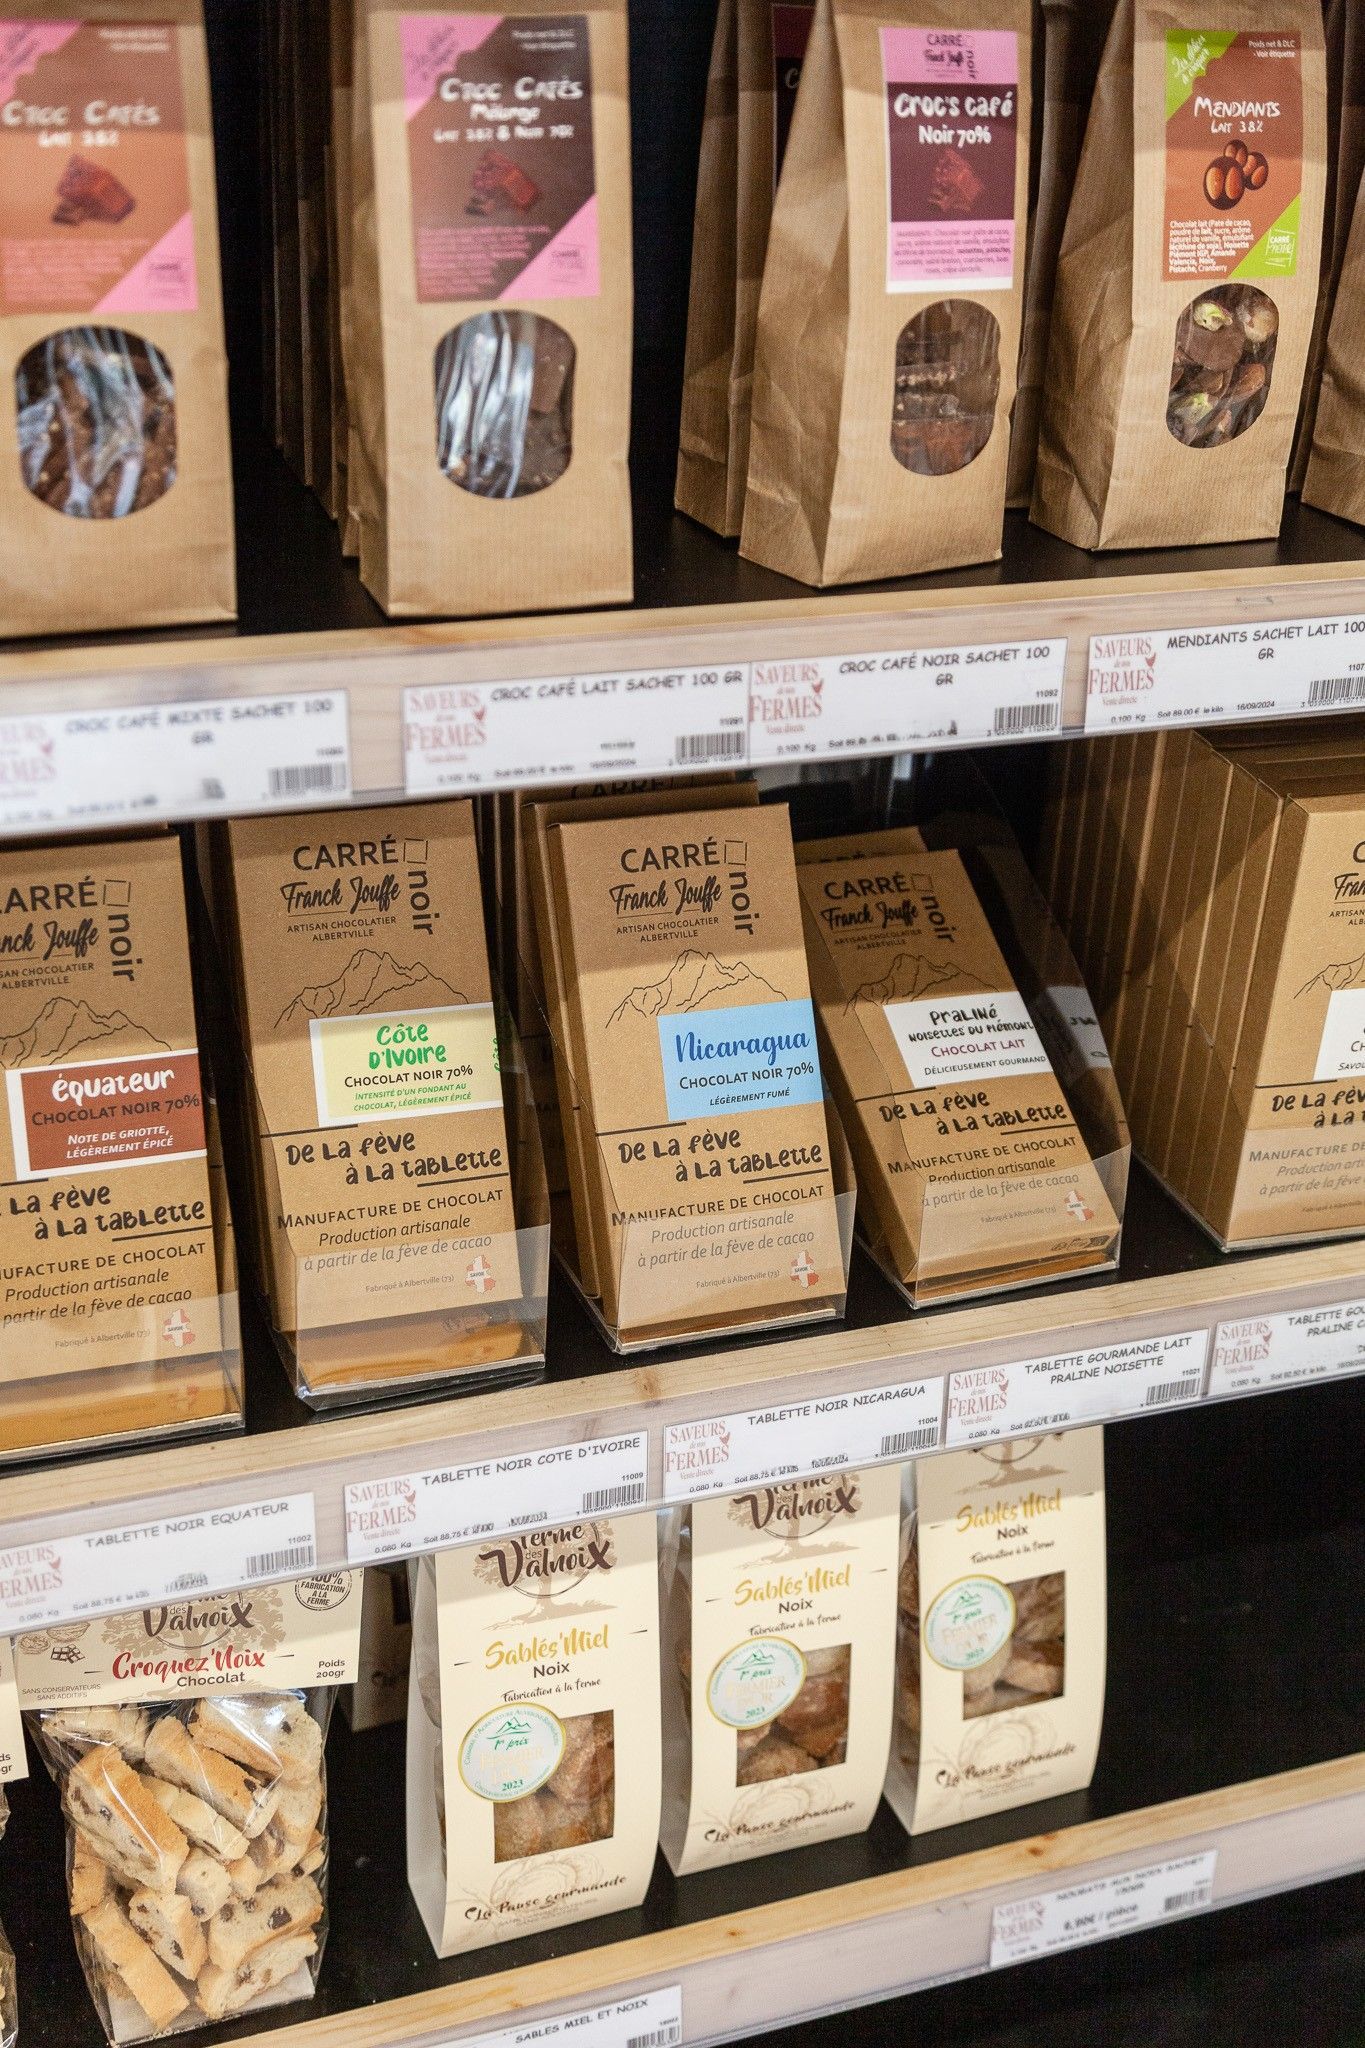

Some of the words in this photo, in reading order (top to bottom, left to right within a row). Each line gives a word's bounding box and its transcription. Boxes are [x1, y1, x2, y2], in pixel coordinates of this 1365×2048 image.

[919, 124, 954, 144] Noir
[957, 125, 992, 147] 70%
[1167, 631, 1248, 649] MENDIANTS
[1253, 627, 1303, 642] SACHET
[1308, 624, 1339, 636] LAIT
[1344, 621, 1365, 634] 100
[839, 660, 877, 674] CROC
[882, 652, 916, 669] CAFÉ
[923, 654, 960, 667] NOIR
[966, 649, 1020, 664] SACHET
[1026, 646, 1050, 659] 100
[1094, 638, 1152, 660] SAVEURS
[1258, 648, 1274, 660] GR
[490, 685, 530, 701] CROC
[537, 678, 575, 698] CAFÉ
[582, 679, 618, 696] LAIT
[626, 675, 684, 690] SACHET
[692, 672, 719, 686] 100
[724, 670, 743, 685] GR
[935, 673, 954, 687] GR
[1088, 669, 1155, 695] FERMES
[304, 699, 333, 713] 100
[1237, 700, 1275, 711] 16/09/2024
[1135, 714, 1146, 722] Kg
[293, 834, 399, 871] CARRÉ
[620, 836, 720, 873] CARRÉ
[280, 877, 343, 913] Franck
[350, 874, 401, 914] Jouffe
[824, 871, 910, 899] CARRÉ
[407, 870, 440, 936] noir
[729, 871, 760, 936] noir
[287, 922, 328, 933] ARTISAN
[331, 916, 397, 930] CHOCOLATIER
[312, 929, 374, 941] ALBERTVILLE
[107, 913, 143, 982] noir
[21, 962, 95, 976] CHOCOLATIER
[1, 976, 70, 989] ALBERTVILLE
[377, 1023, 429, 1046] Côte
[676, 1031, 811, 1066] Nicaragua
[931, 1041, 997, 1058] CHOCOLAT
[1000, 1039, 1026, 1050] LAIT
[344, 1074, 410, 1088] CHOCOLAT
[414, 1069, 443, 1081] NOIR
[446, 1064, 473, 1081] 70%
[679, 1072, 748, 1090] CHOCOLAT
[752, 1069, 783, 1081] NOIR
[786, 1062, 814, 1080] 70%
[924, 1059, 997, 1076] DÉLICIEUSEMENT
[999, 1055, 1046, 1066] GOURMAND
[51, 1068, 174, 1107] équateur
[355, 1090, 395, 1100] INTENSITÉ
[397, 1087, 416, 1096] D'UN
[418, 1084, 454, 1095] FONDANT
[710, 1092, 765, 1106] LÉGÈREMENT
[767, 1088, 790, 1098] FUMÉ
[32, 1105, 117, 1126] CHOCOLAT
[122, 1100, 160, 1116] NOIR
[165, 1094, 200, 1114] 70%
[354, 1101, 396, 1111] CHOCOLAT,
[398, 1095, 448, 1107] LÉGÈREMENT
[450, 1091, 472, 1102] ÉPICÉ
[67, 1132, 98, 1145] NOTE
[102, 1131, 116, 1141] DE
[120, 1125, 169, 1140] GRIOTTE,
[66, 1142, 139, 1159] LÉGÈREMENT
[143, 1135, 174, 1150] ÉPICÉ
[278, 1203, 398, 1229] MANUFACTURE
[403, 1201, 421, 1213] DE
[427, 1189, 503, 1209] CHOCOLAT
[318, 1226, 397, 1246] Production
[401, 1214, 471, 1235] artisanale
[96, 1255, 117, 1268] DE
[123, 1242, 206, 1265] CHOCOLAT
[5, 1281, 89, 1301] Production
[94, 1268, 169, 1291] artisanale
[1025, 1355, 1084, 1374] TABLETTE
[1087, 1342, 1160, 1363] GOURMANDE
[1164, 1337, 1192, 1349] LAIT
[1050, 1369, 1100, 1385] PRALINE
[1104, 1356, 1164, 1375] NOISETTE
[747, 1405, 811, 1426] TABLETTE
[815, 1399, 849, 1413] NOIR
[853, 1385, 926, 1406] NICARAGUA
[918, 1416, 938, 1425] 11004
[422, 1464, 491, 1486] TABLETTE
[496, 1458, 533, 1472] NOIR
[537, 1450, 572, 1466] COTE
[578, 1437, 640, 1458] D'IVOIRE
[622, 1472, 644, 1481] 11009
[713, 1481, 723, 1489] Kg
[350, 1479, 412, 1504] SAVEURS
[85, 1525, 160, 1549] TABLETTE
[165, 1518, 205, 1534] NOIR
[211, 1502, 289, 1527] EQUATEUR
[346, 1504, 417, 1532] FERMES
[287, 1534, 312, 1545] 11002
[301, 1582, 345, 1593] FABRICATION
[307, 1596, 330, 1606] FERME
[779, 1598, 813, 1614] Noix
[316, 1668, 345, 1679] 200gr
[318, 1658, 346, 1669] Poids
[533, 1661, 570, 1678] Noix
[177, 1671, 246, 1688] Chocolat
[501, 1687, 552, 1703] Fabrication
[502, 1779, 523, 1791] 2023
[515, 2024, 560, 2044] SABLES
[564, 2014, 594, 2030] MIEL
[597, 2008, 611, 2020] ET
[616, 1998, 649, 2015] NOIX
